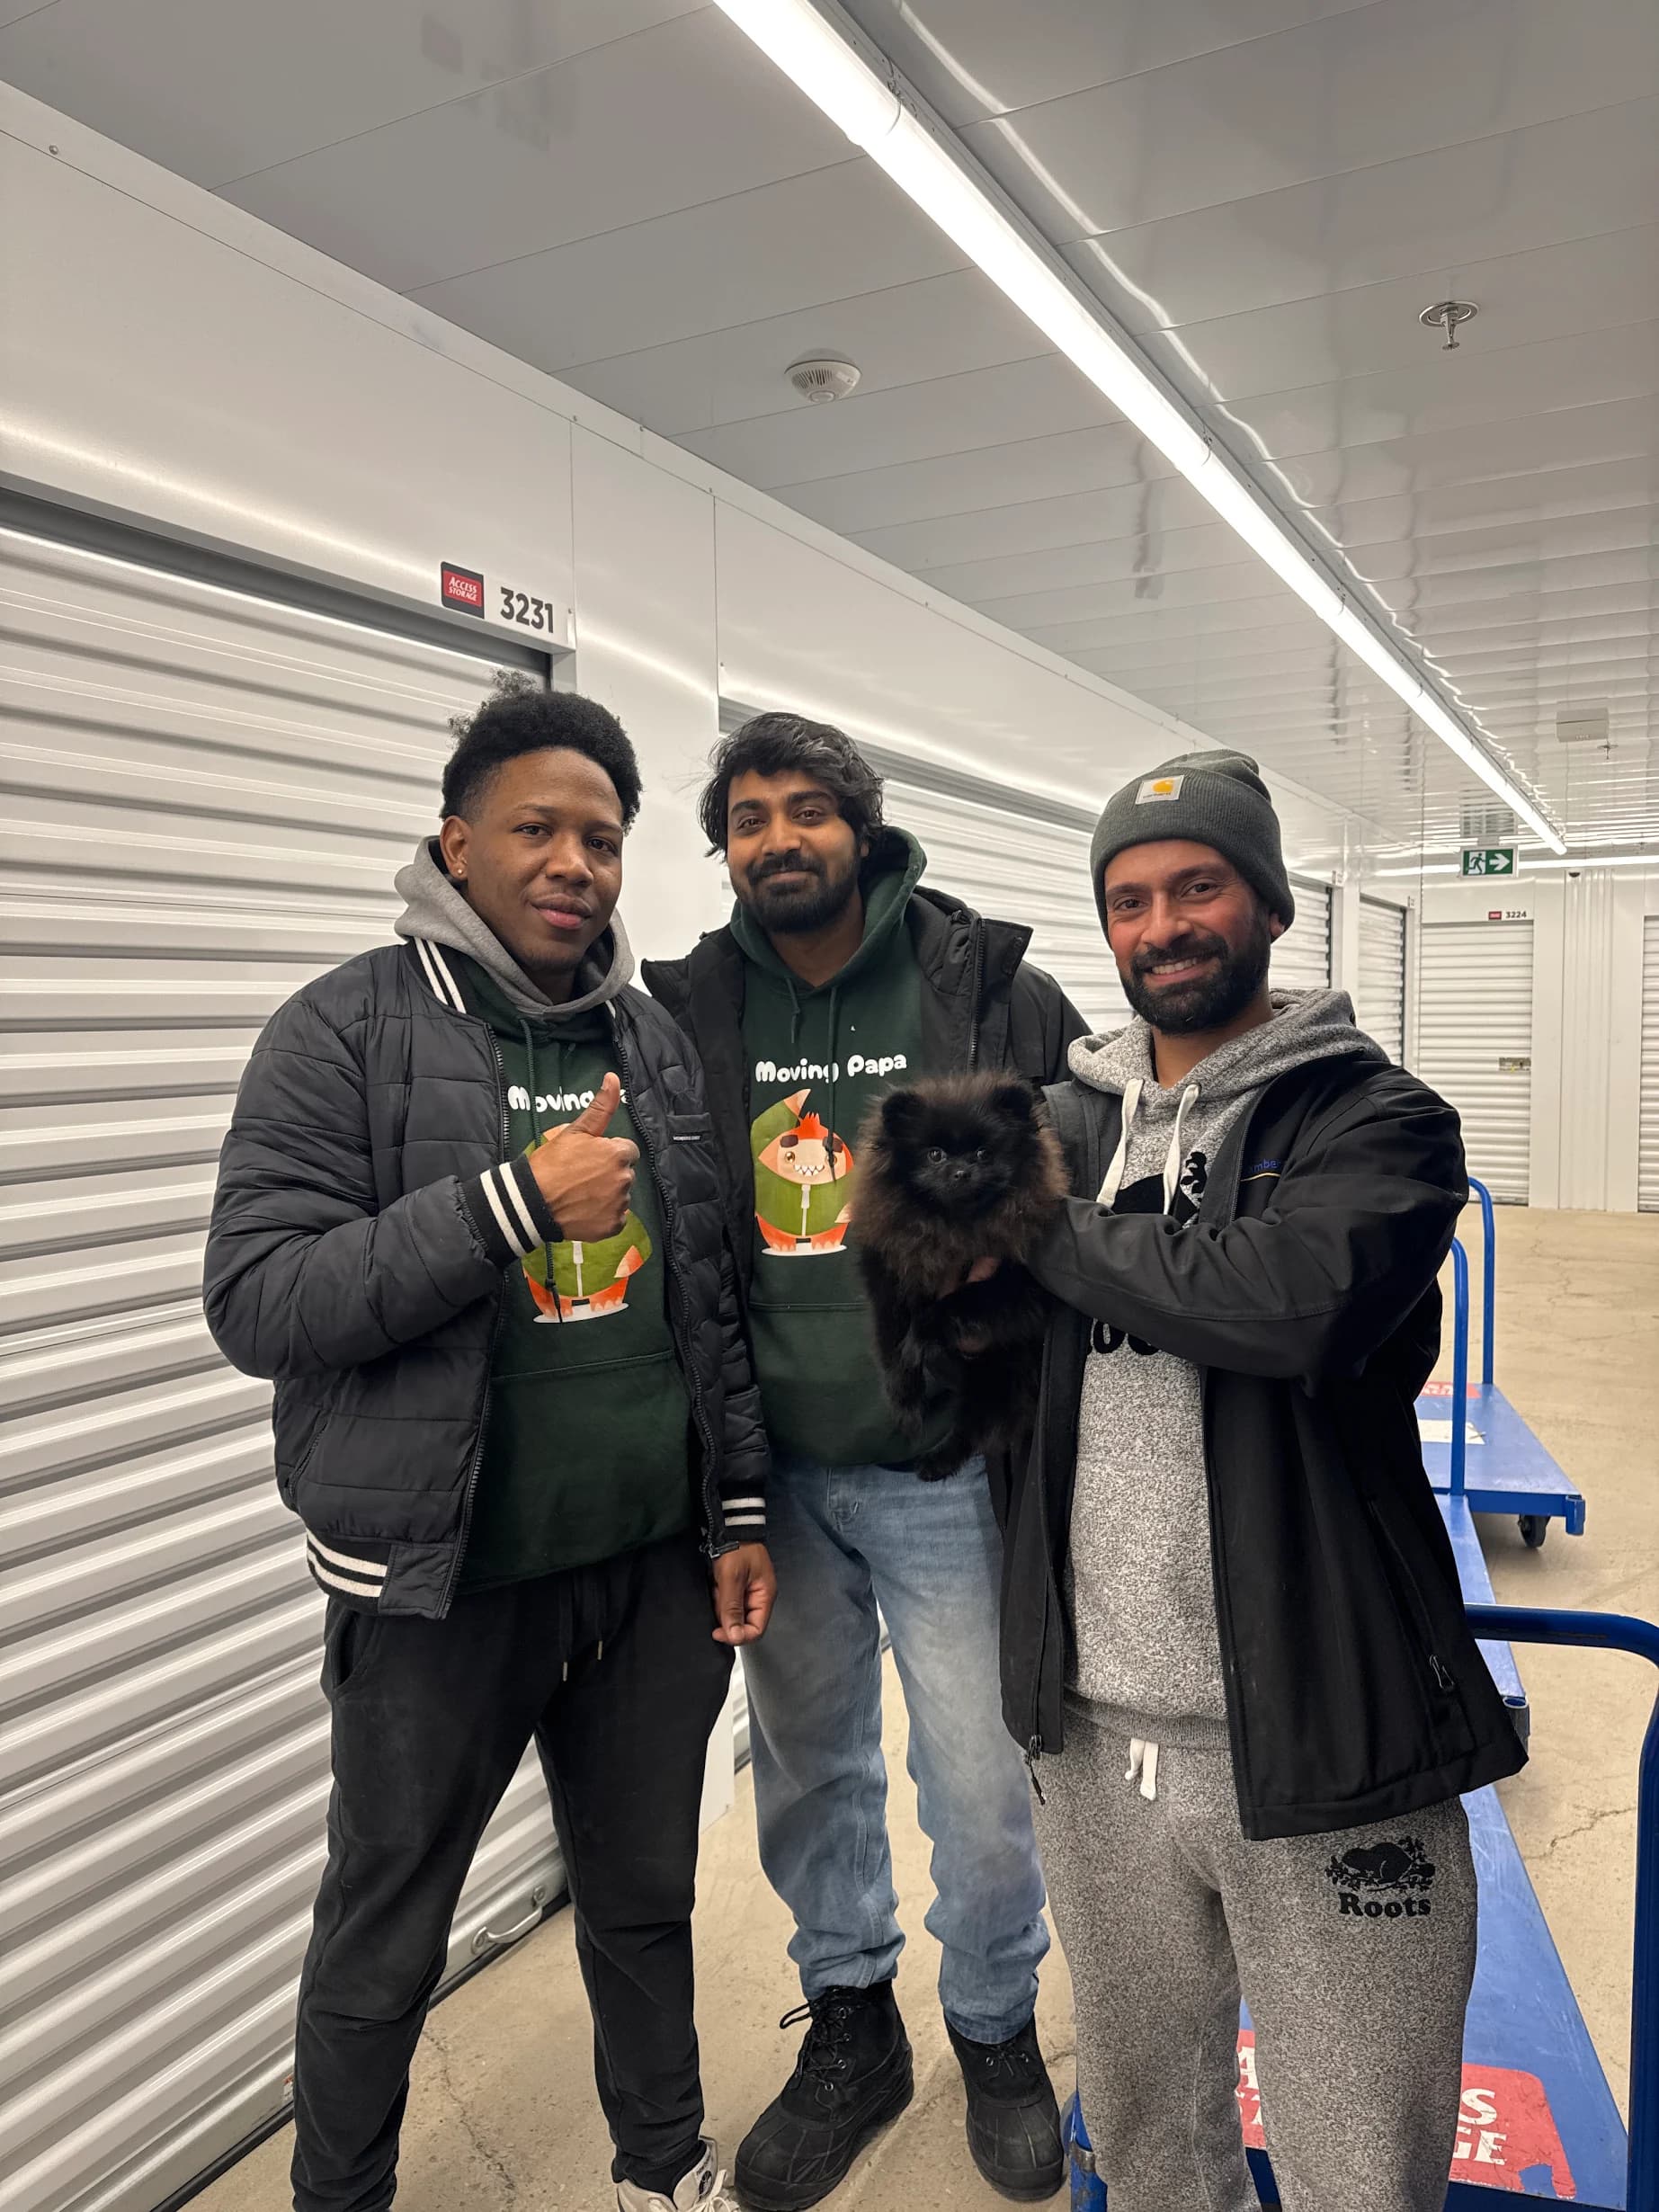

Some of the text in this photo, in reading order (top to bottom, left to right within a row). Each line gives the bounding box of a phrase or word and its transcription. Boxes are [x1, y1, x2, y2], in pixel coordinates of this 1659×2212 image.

[449, 575, 477, 594] ACCESS
[449, 585, 477, 602] STORAGE
[500, 586, 554, 634] 3231
[1505, 910, 1528, 919] 3224
[755, 1053, 907, 1084] Moving Papa
[1337, 1891, 1432, 1918] Roots
